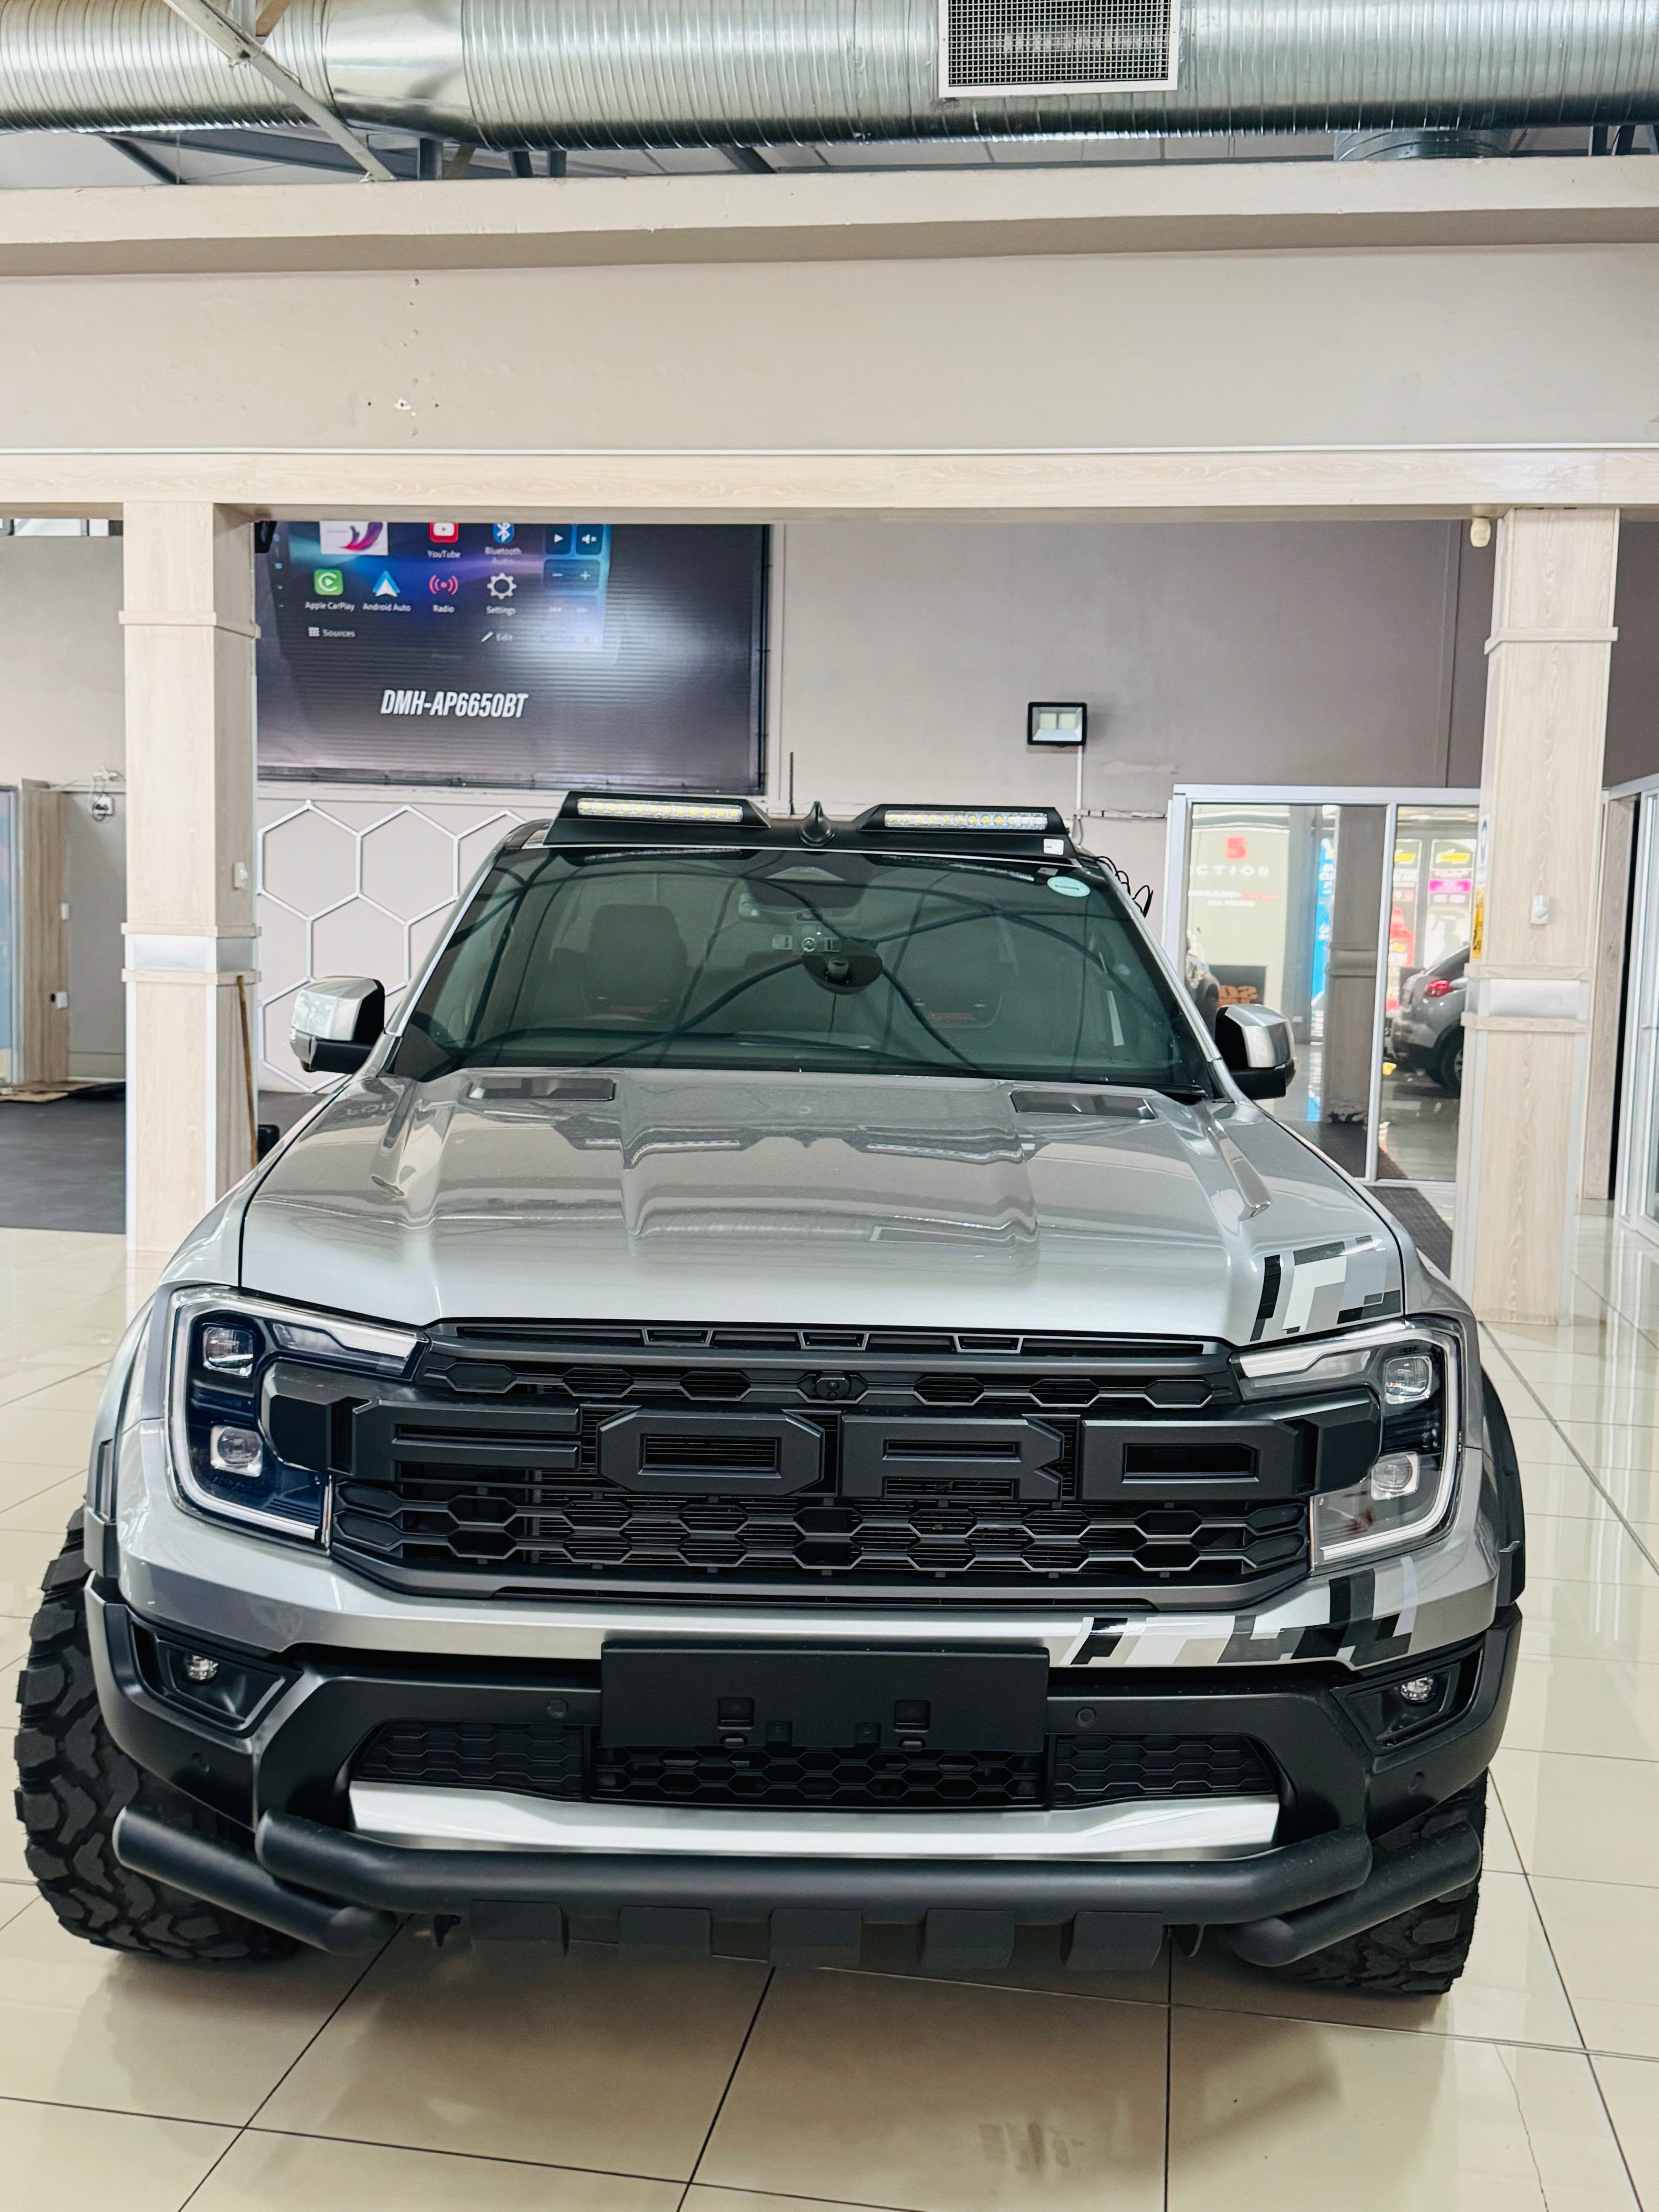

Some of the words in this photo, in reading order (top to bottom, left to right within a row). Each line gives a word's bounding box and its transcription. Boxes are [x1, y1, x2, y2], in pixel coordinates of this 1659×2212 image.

[427, 550, 461, 558] YouTube
[484, 547, 521, 555] Bluetooth
[305, 601, 326, 610] Apple
[327, 602, 355, 612] CarPlay
[363, 603, 392, 611] Android
[433, 604, 454, 613] Radio
[486, 606, 516, 616] Settings
[323, 628, 356, 638] Sources
[380, 690, 529, 718] DMH-AP6650BT
[352, 1399, 1300, 1502] FORD
